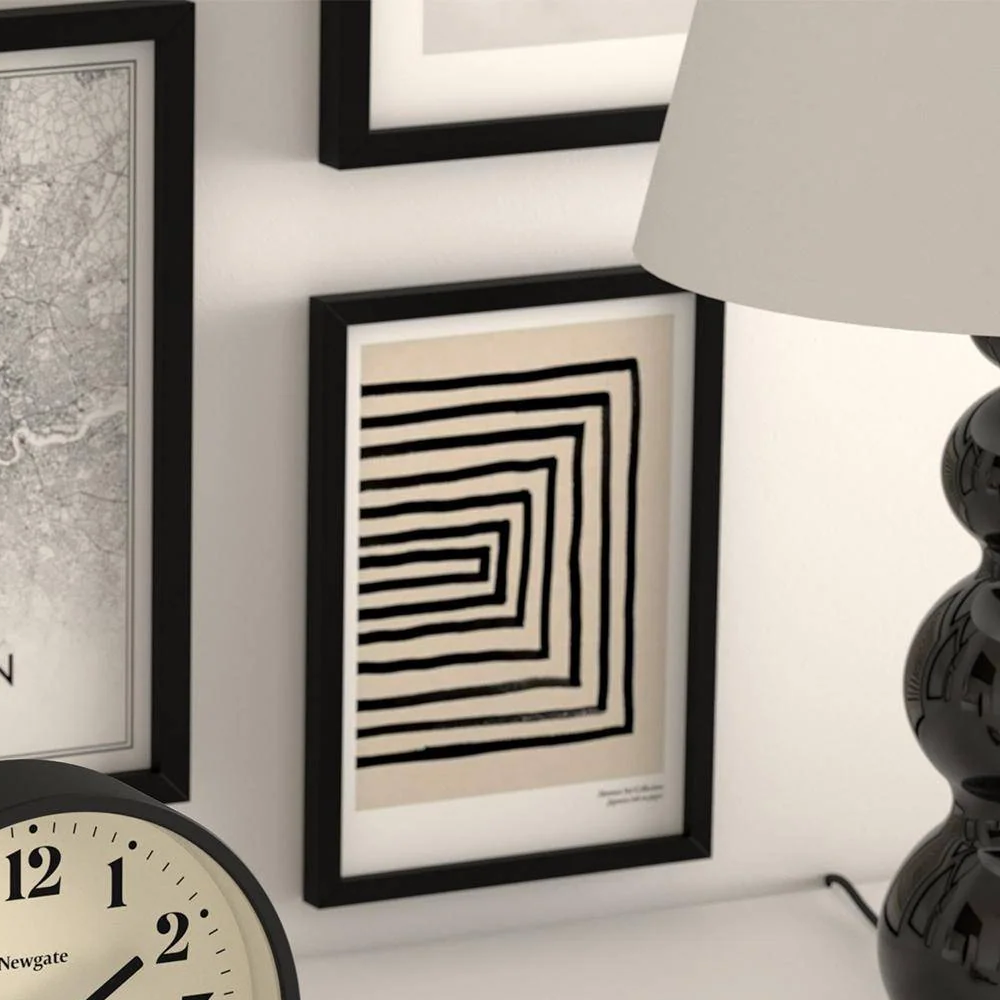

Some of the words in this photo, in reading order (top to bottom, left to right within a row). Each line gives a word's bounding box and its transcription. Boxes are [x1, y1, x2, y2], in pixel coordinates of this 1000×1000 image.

[5, 845, 62, 902] 12
[107, 856, 127, 909] 1
[156, 911, 190, 964] 2
